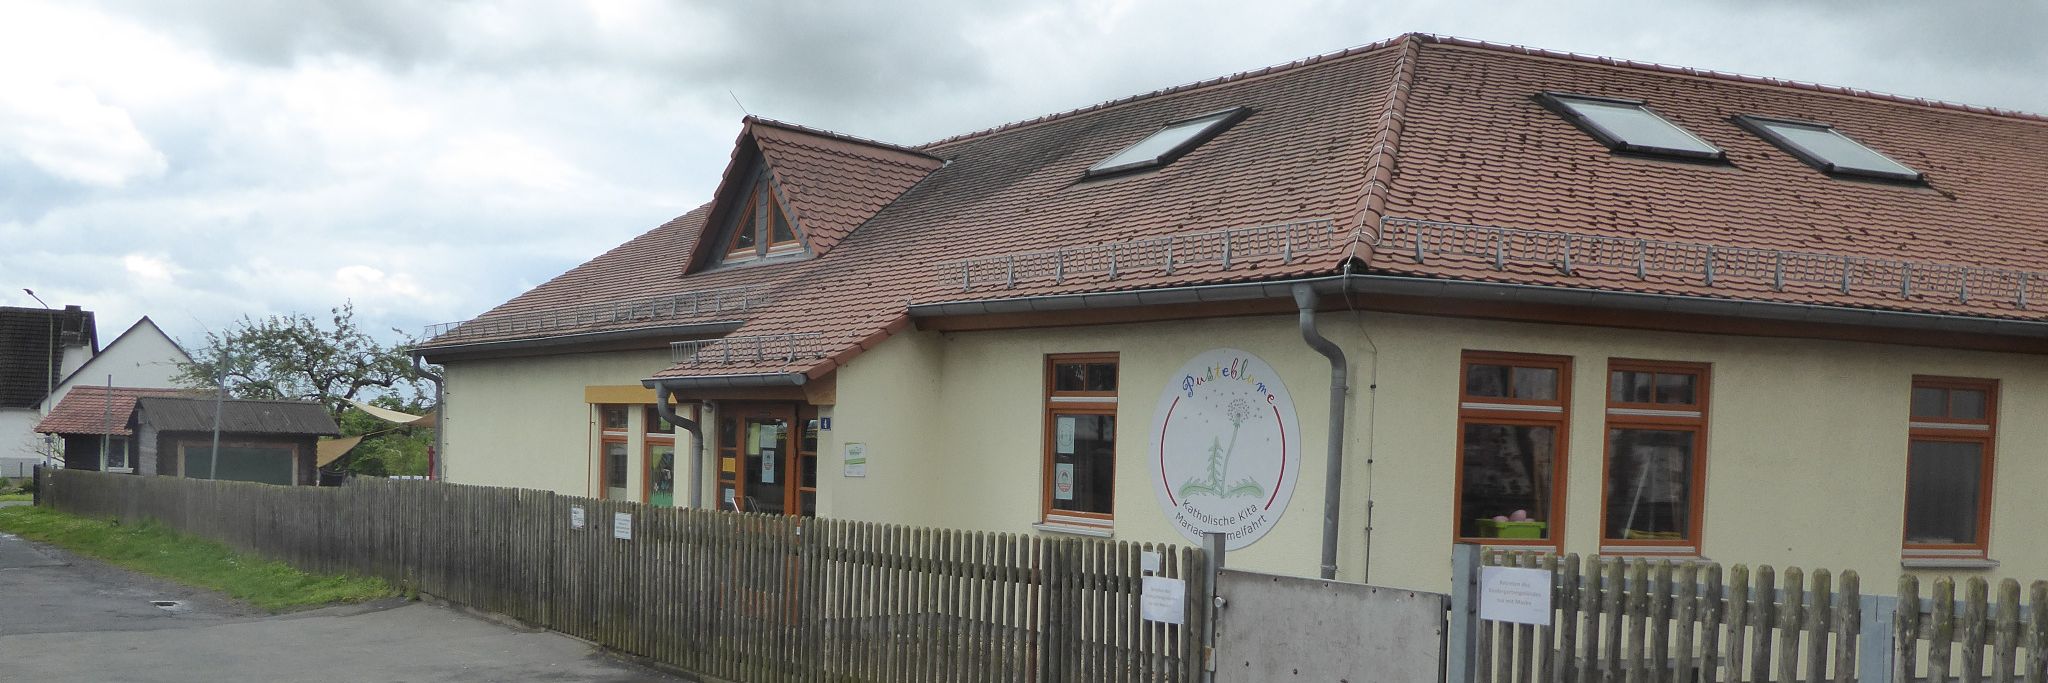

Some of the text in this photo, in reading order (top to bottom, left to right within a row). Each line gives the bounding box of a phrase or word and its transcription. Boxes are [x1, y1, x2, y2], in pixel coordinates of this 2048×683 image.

[1182, 358, 1275, 405] Pusteblume
[1175, 512, 1267, 541] Mariae melfahrt
[1182, 499, 1258, 526] Katholische Kita
